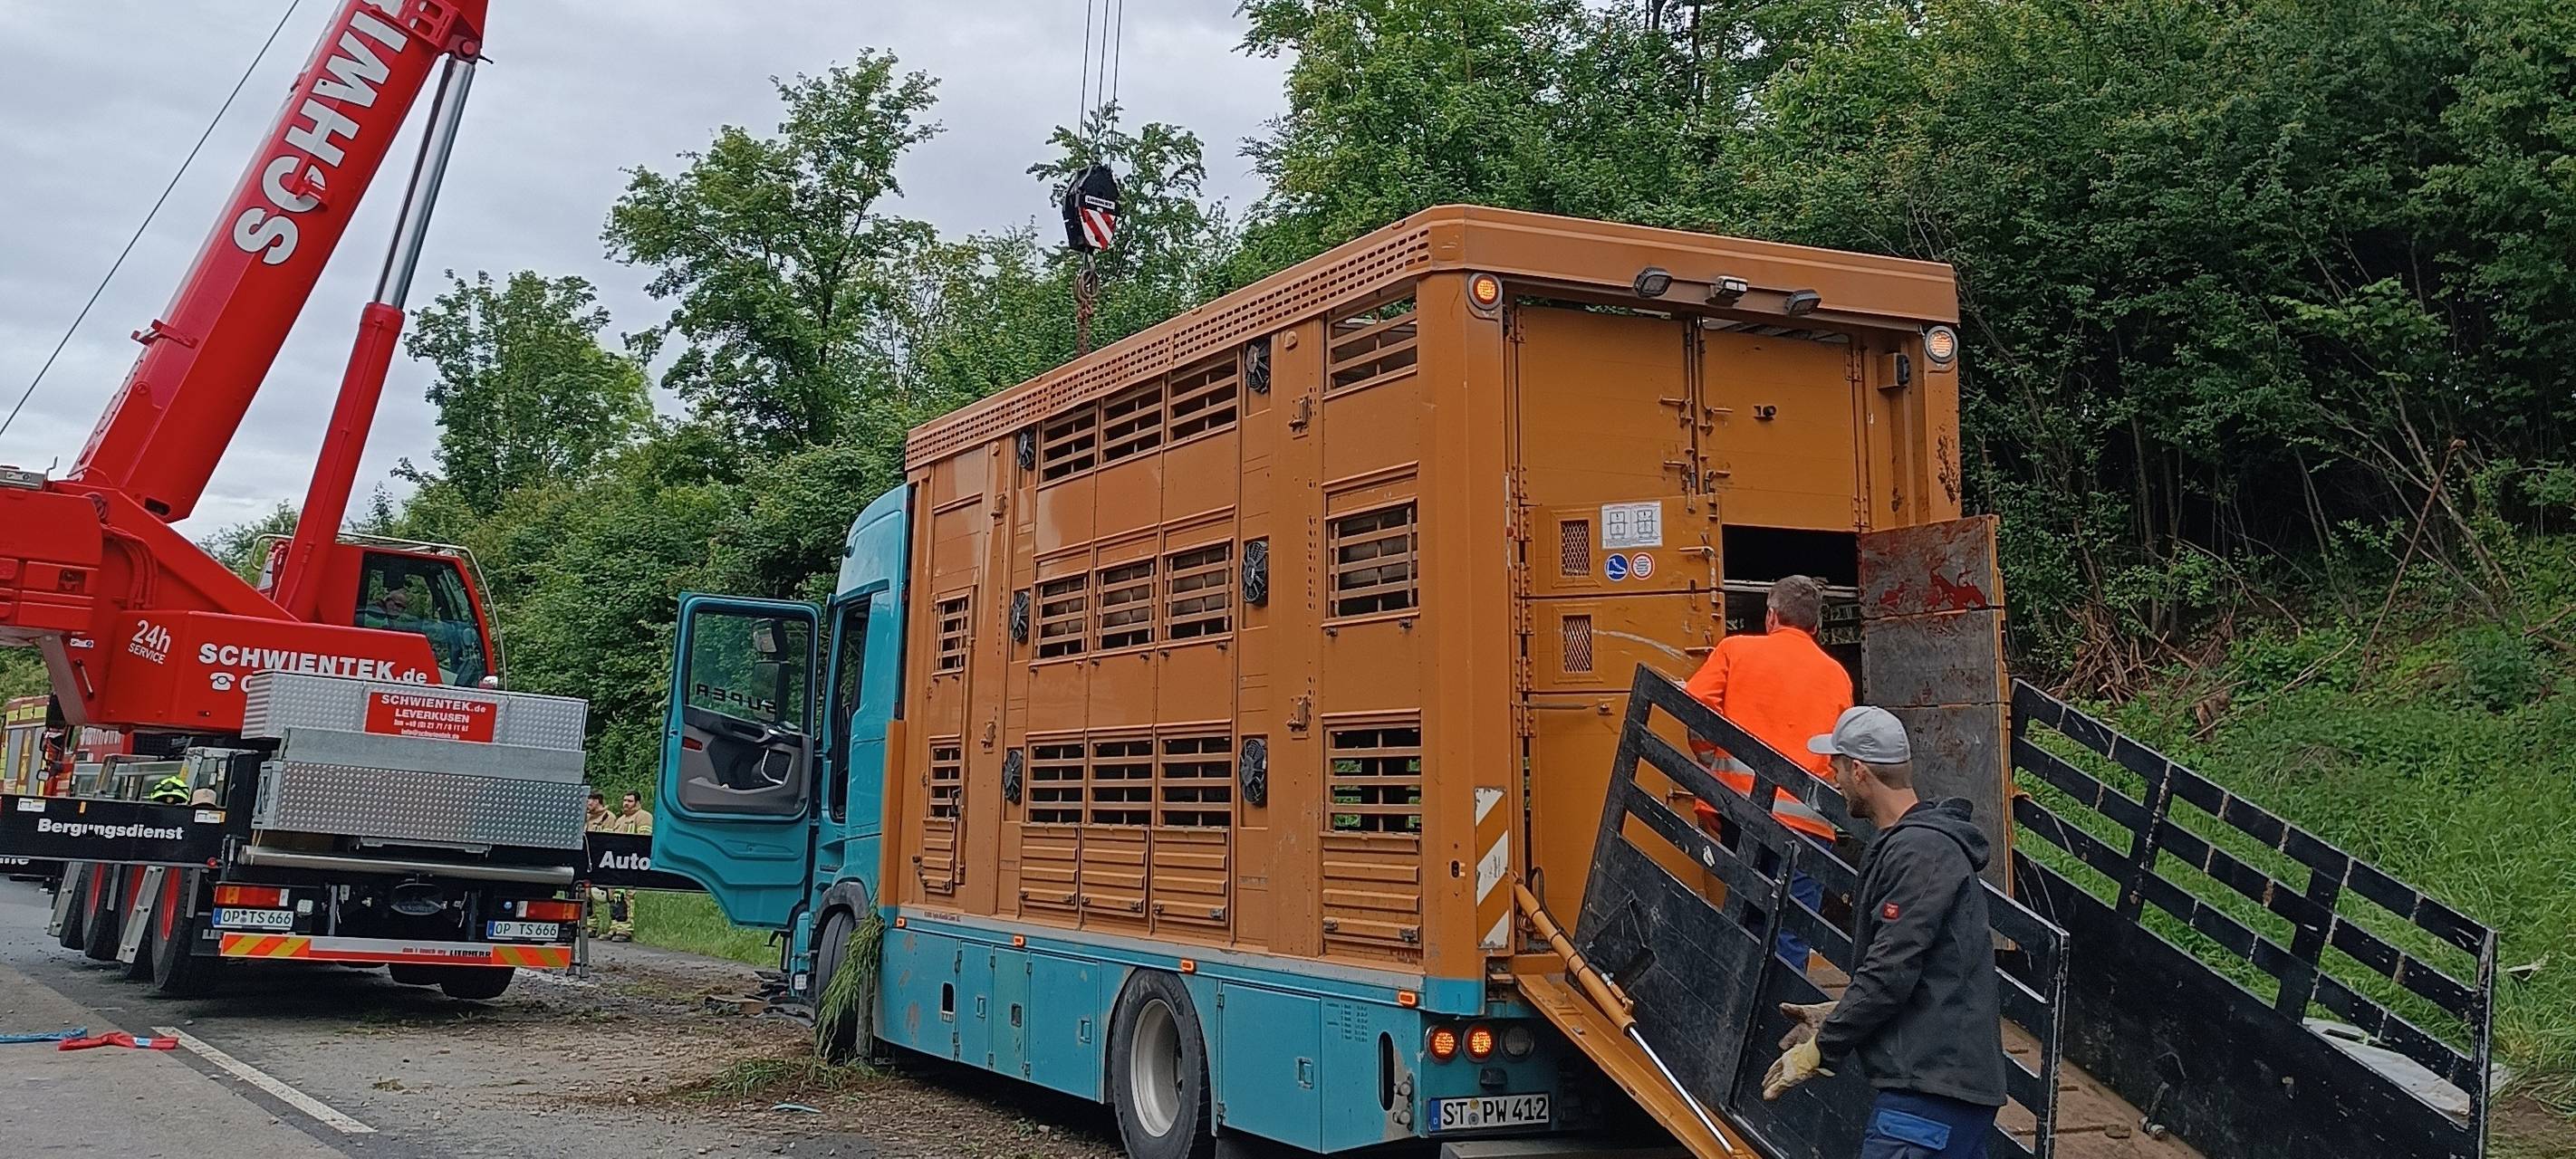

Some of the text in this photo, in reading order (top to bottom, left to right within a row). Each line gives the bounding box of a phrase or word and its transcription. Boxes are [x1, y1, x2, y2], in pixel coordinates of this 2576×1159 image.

[131, 619, 171, 653] 24h
[128, 642, 167, 665] SERVICE
[197, 642, 428, 685] SCHWIENTEK.de
[381, 694, 486, 713] SCHWIENTEK.de
[395, 708, 470, 723] LEVERKUSEN
[599, 850, 651, 870] Auto
[223, 910, 292, 924] OP TS 666
[495, 923, 557, 936] OP TS 666
[1443, 1101, 1468, 1125] ST
[1483, 1099, 1507, 1124] PW
[1512, 1097, 1547, 1122] 412
